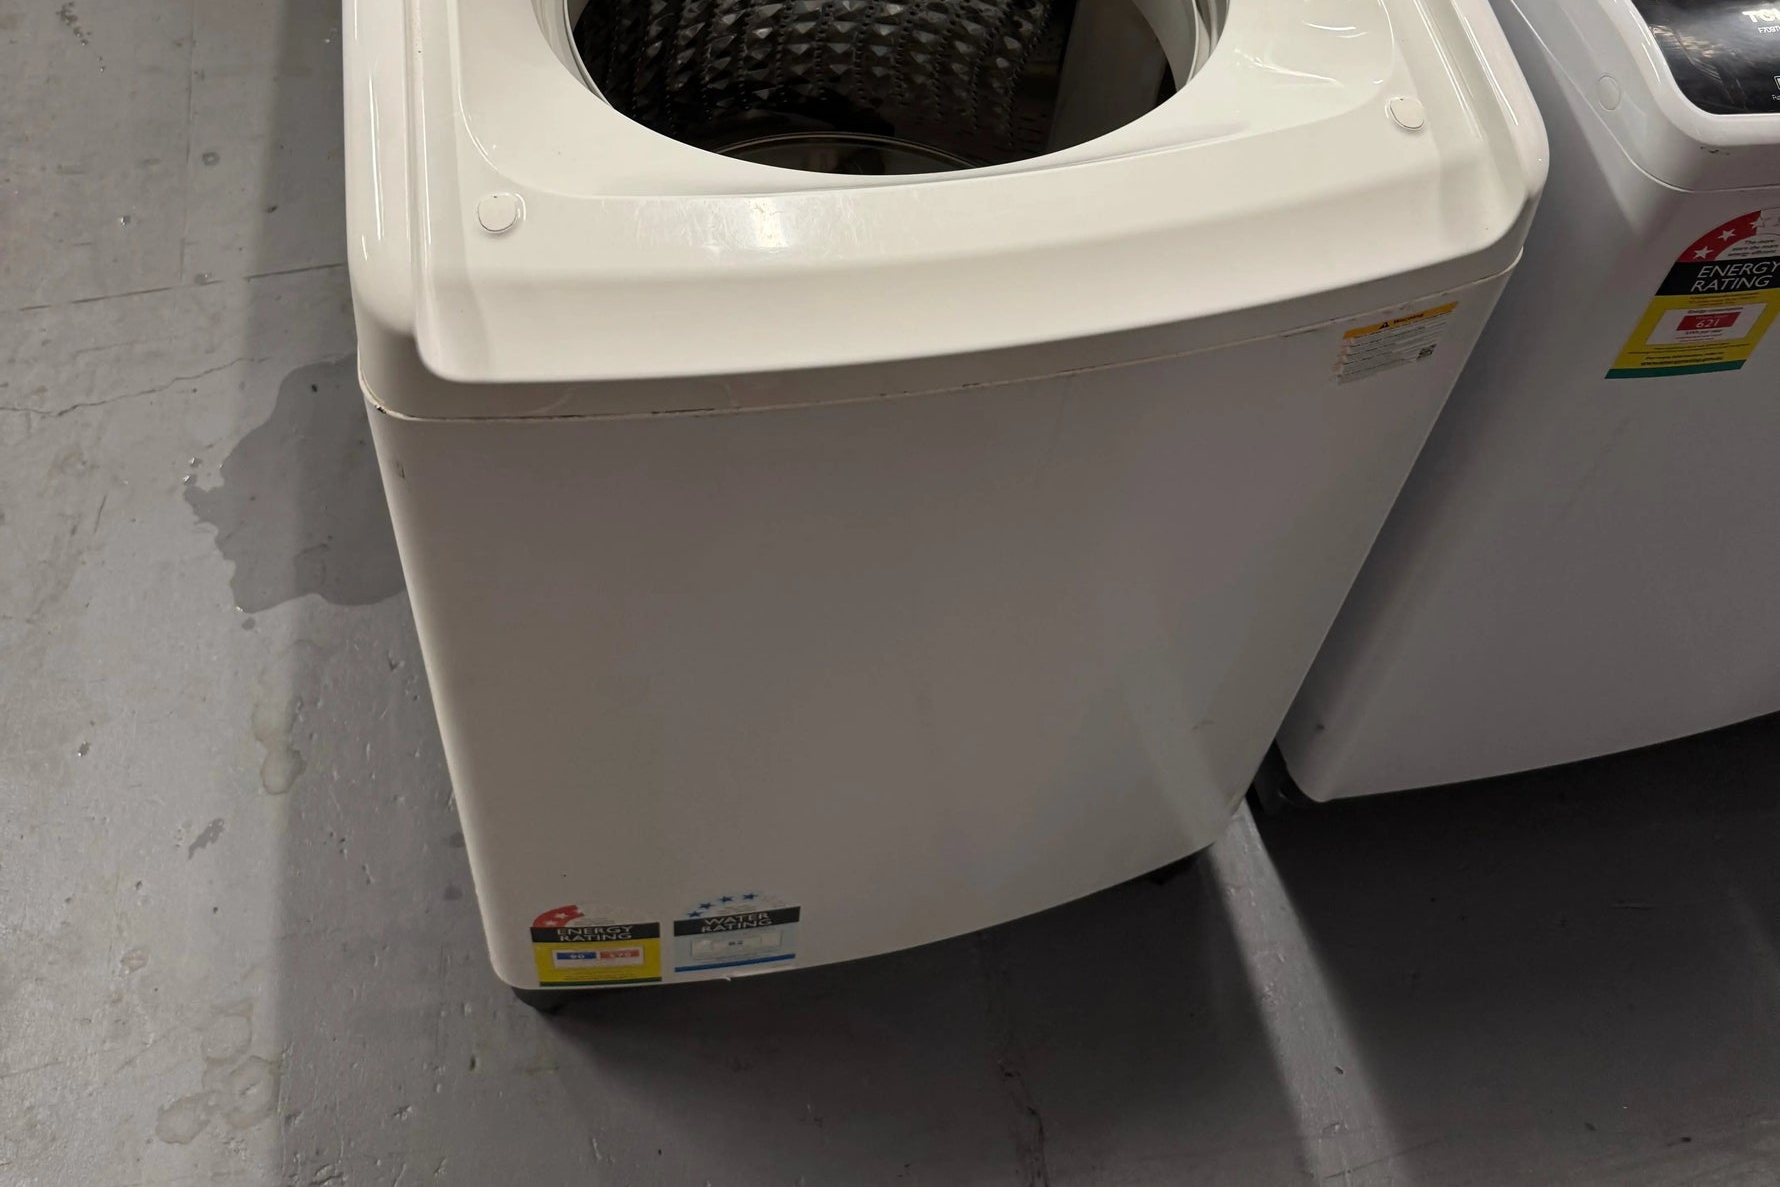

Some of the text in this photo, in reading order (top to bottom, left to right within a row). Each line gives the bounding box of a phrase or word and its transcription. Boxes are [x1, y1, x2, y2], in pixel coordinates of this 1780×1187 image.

[1697, 260, 1780, 278] ENERGY
[1690, 274, 1774, 292] RATING
[1695, 318, 1720, 328] 621
[704, 912, 769, 925] WATER
[556, 925, 633, 935] ENERGY
[701, 918, 773, 933] RATING
[560, 932, 632, 942] RATING
